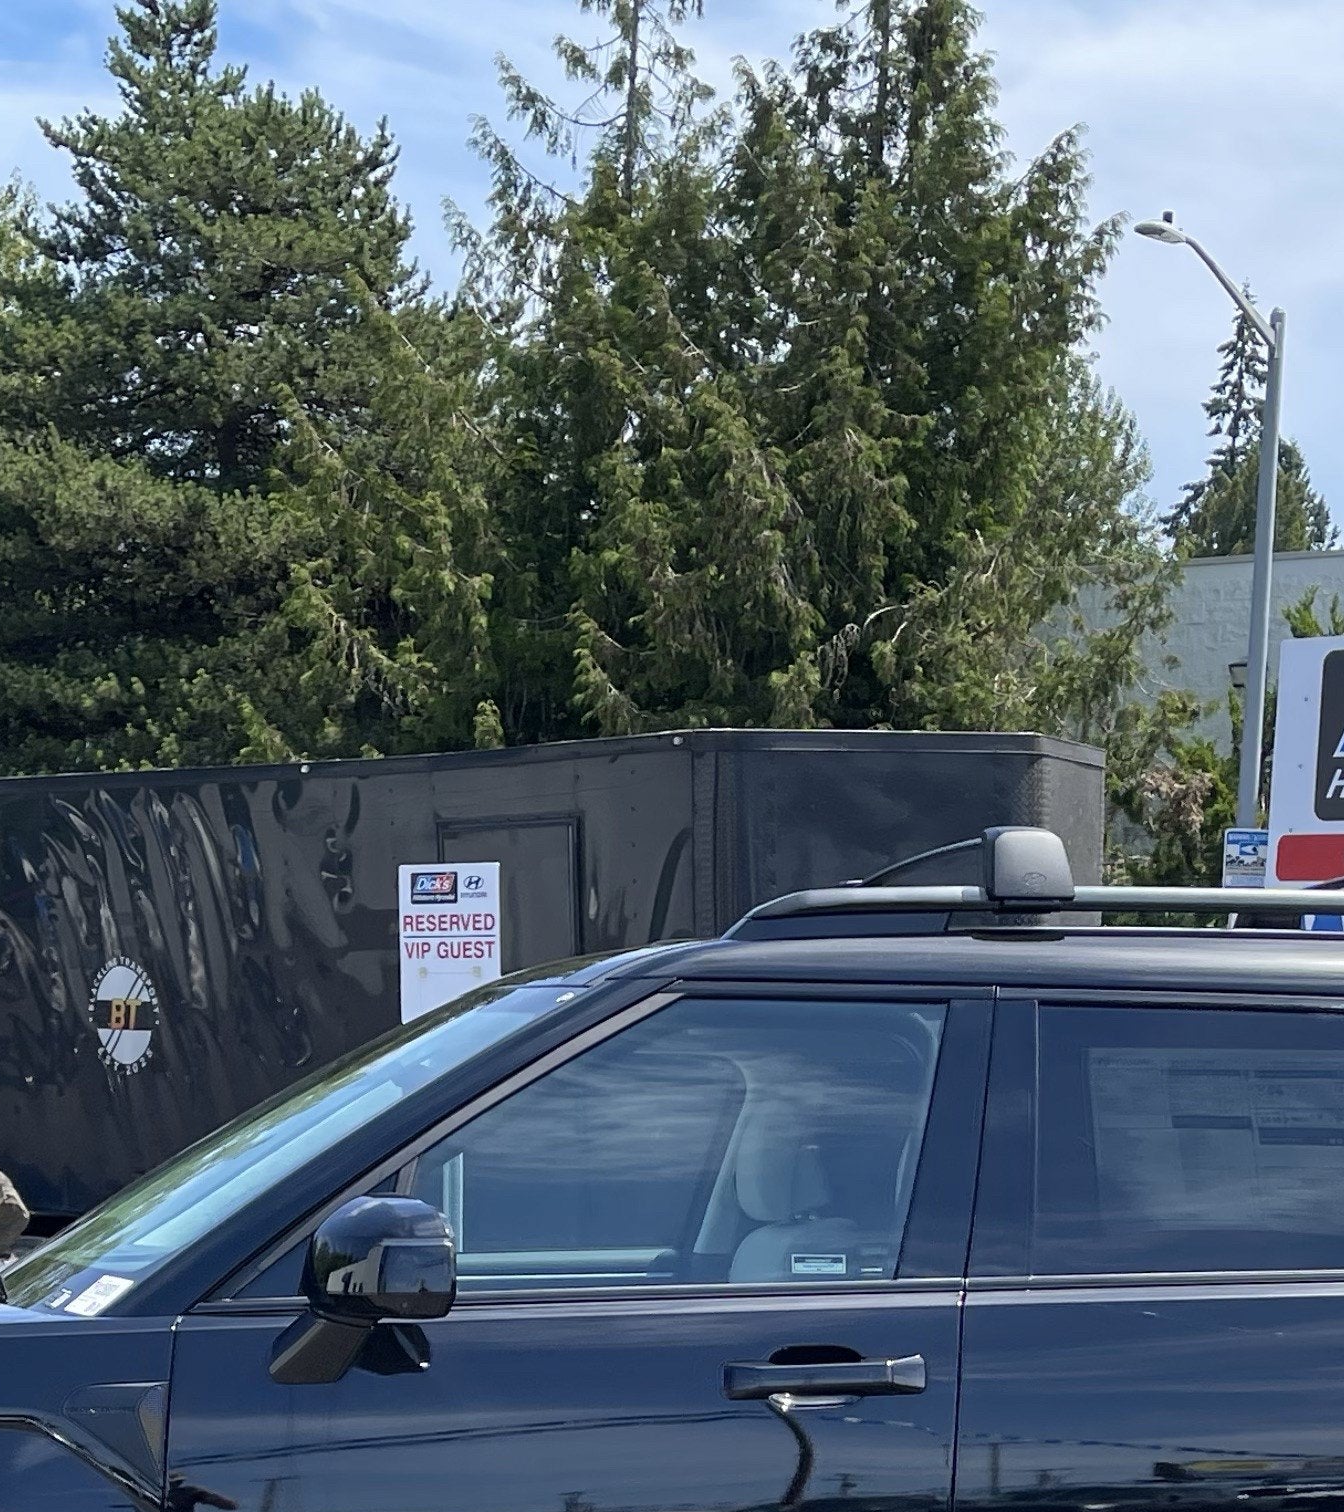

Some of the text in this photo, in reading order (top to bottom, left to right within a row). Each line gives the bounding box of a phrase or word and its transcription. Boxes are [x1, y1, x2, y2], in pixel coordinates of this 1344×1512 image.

[403, 913, 495, 932] RESERVED
[404, 941, 495, 959] VIP GUEST
[110, 998, 142, 1030] BT
